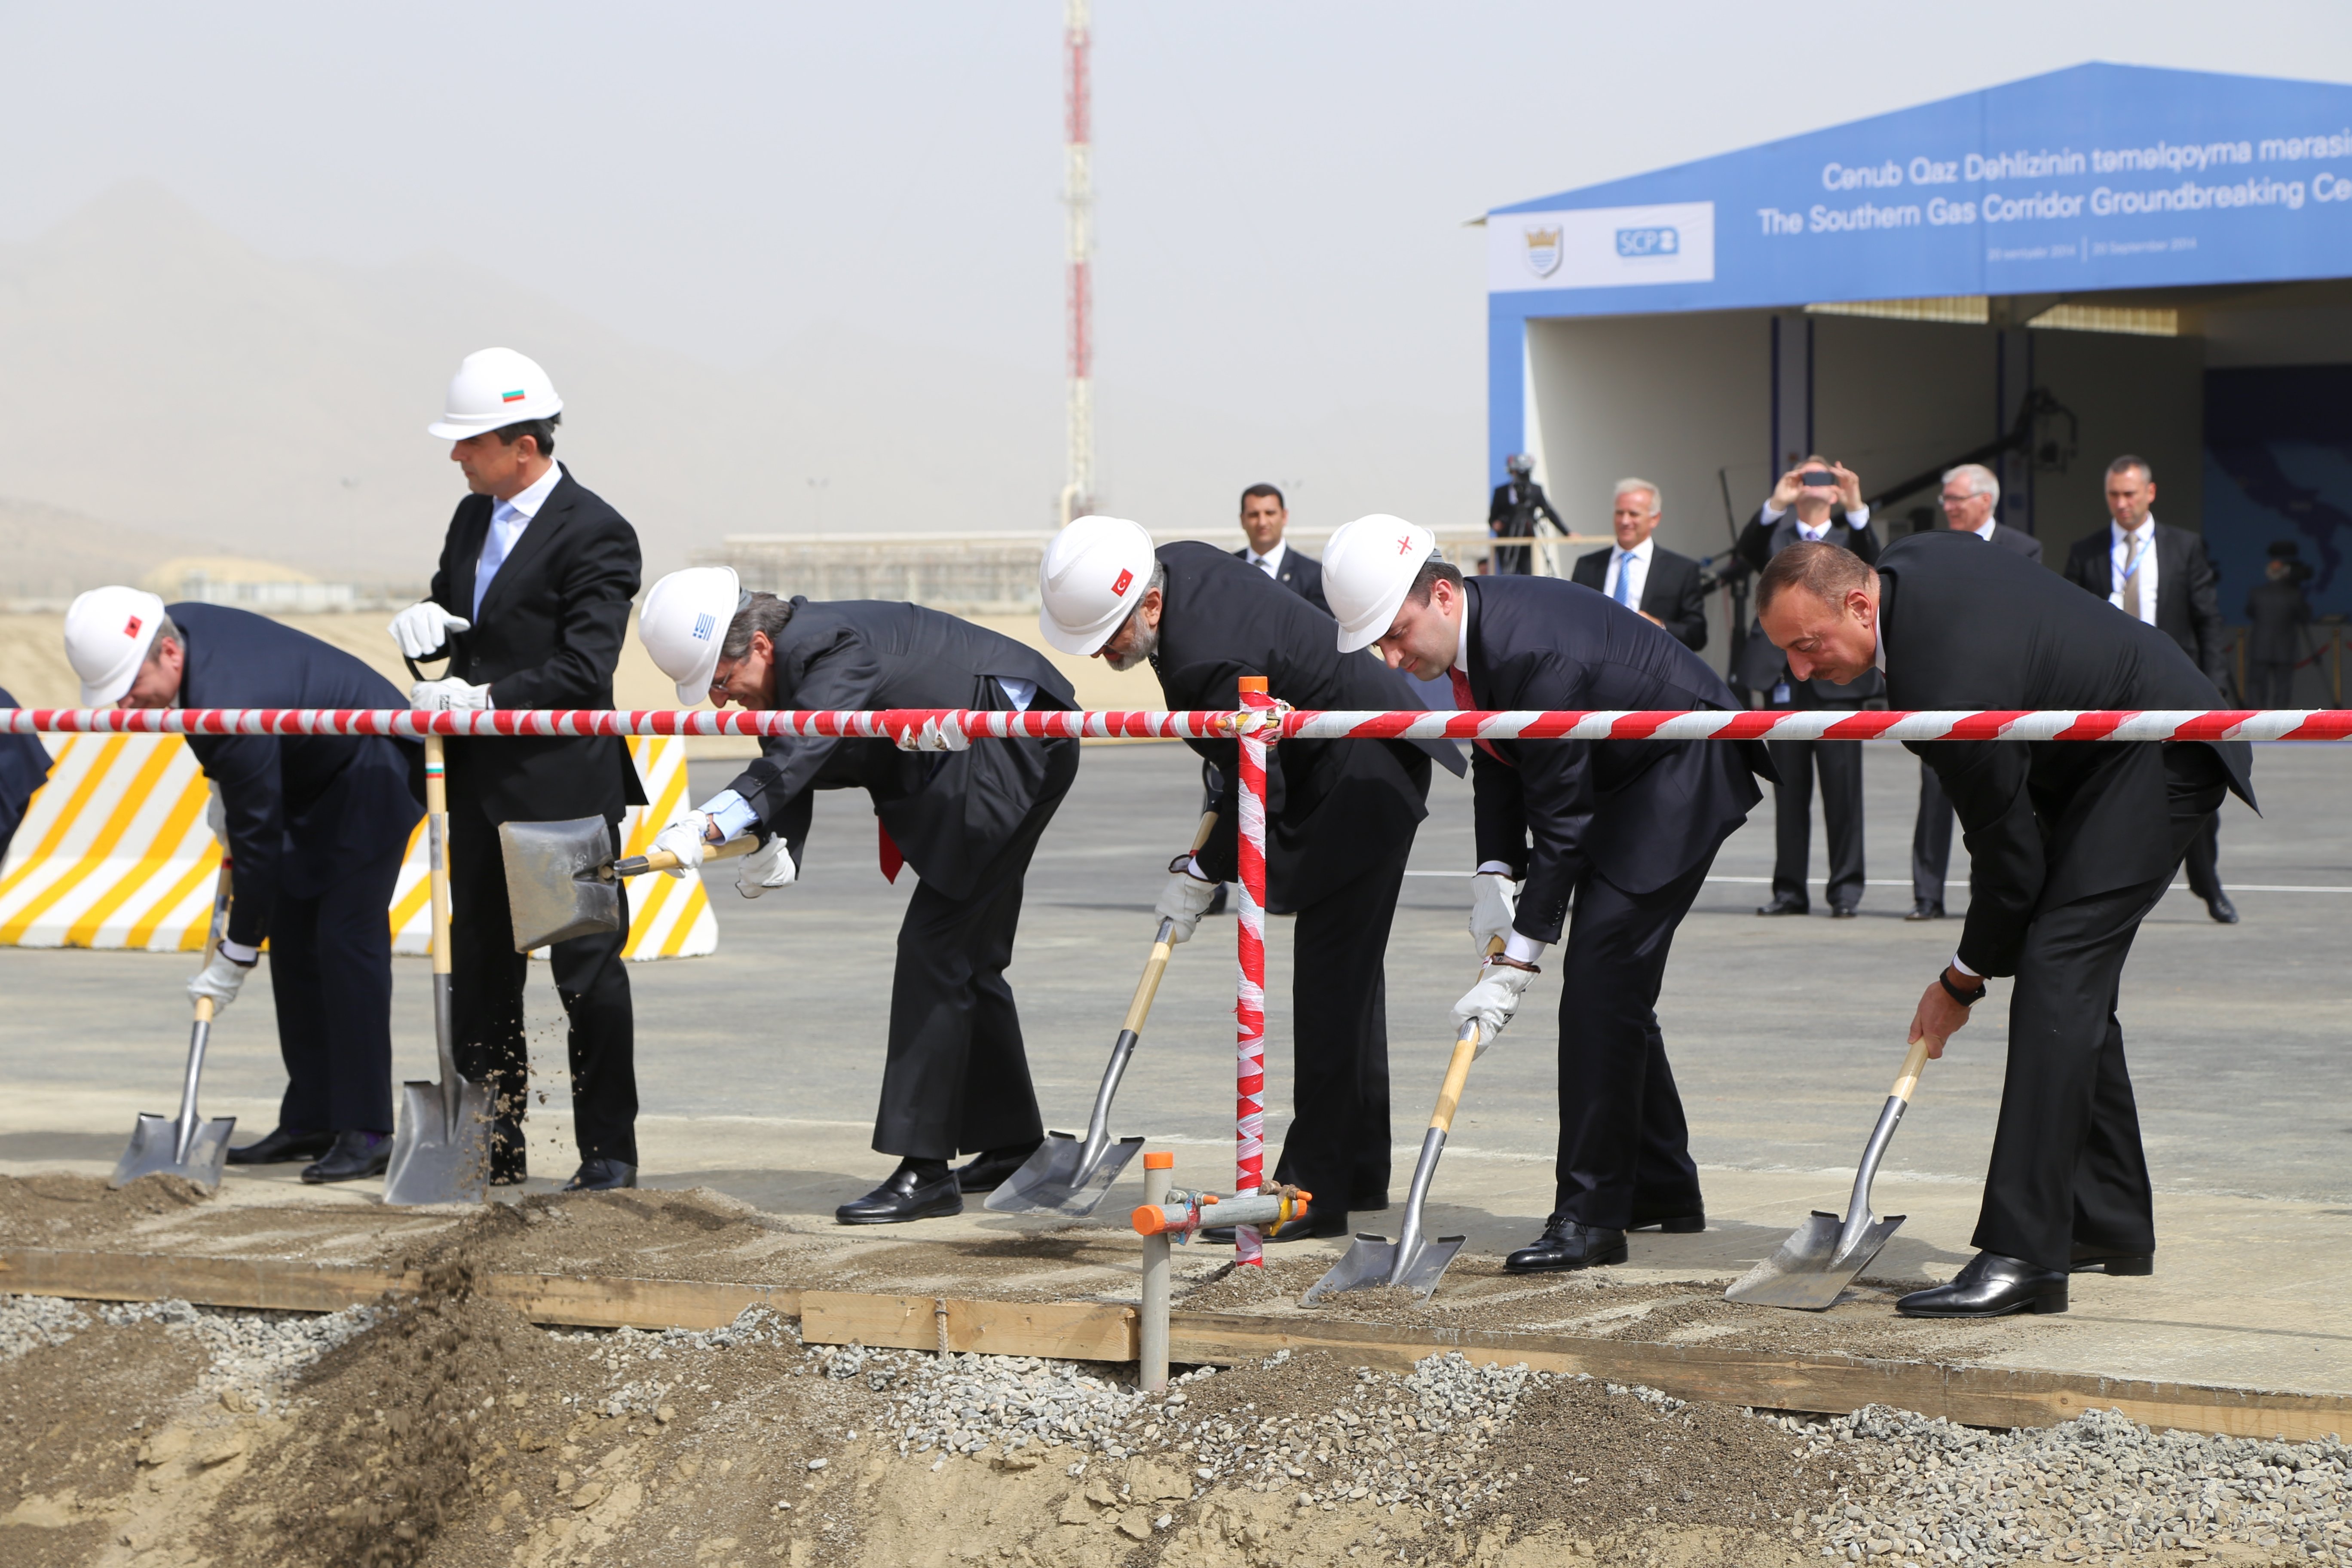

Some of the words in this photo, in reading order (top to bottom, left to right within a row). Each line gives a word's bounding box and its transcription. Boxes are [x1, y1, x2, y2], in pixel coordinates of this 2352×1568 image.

[1909, 156, 1958, 185] Qaz
[2259, 127, 2352, 162] mərasi
[1758, 208, 1804, 235] The
[1809, 202, 1921, 233] Southern
[1927, 196, 1977, 225] Gas
[1982, 190, 2084, 223] Corridor
[2090, 176, 2306, 216] Groundbreaking
[2312, 172, 2352, 202] Ce
